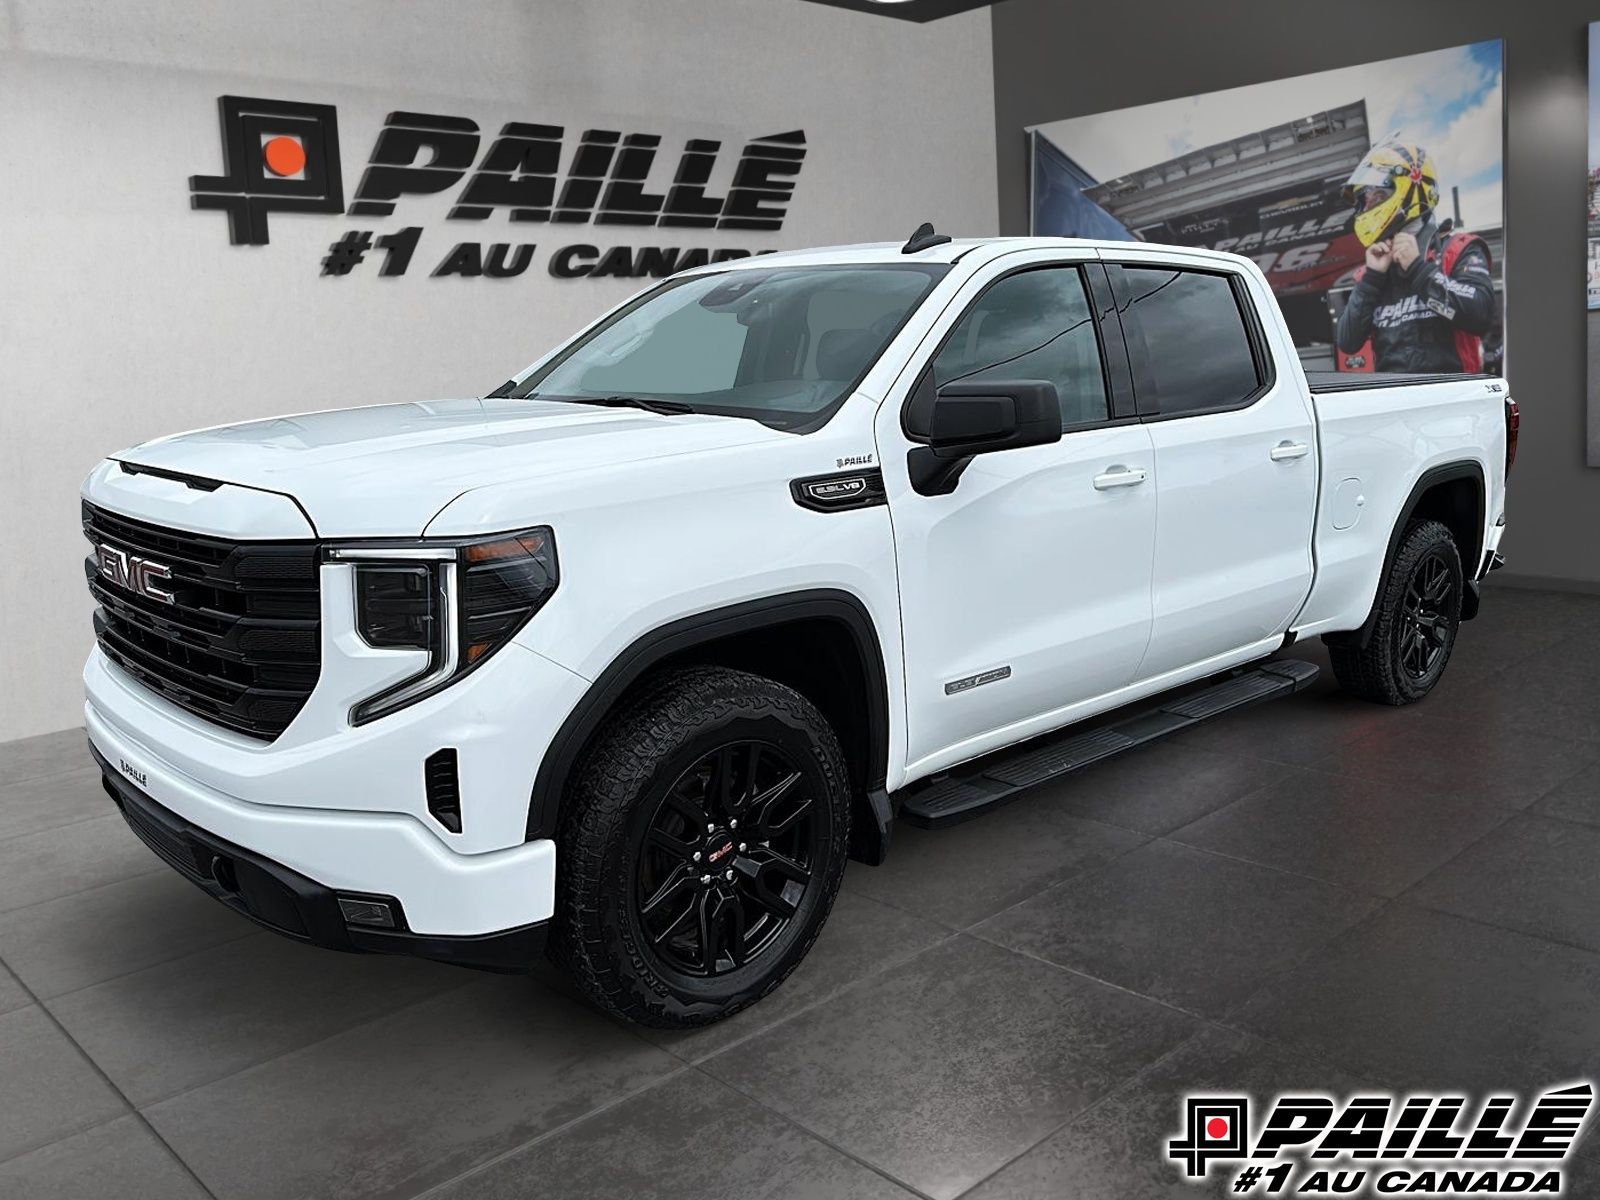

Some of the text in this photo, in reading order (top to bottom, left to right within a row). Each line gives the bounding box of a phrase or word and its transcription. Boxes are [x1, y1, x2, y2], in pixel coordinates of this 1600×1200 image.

[347, 110, 807, 231] PAILLÉ
[319, 226, 779, 280] #1 AU CANA
[844, 453, 872, 466] PAILLÉ
[99, 543, 175, 606] GMC
